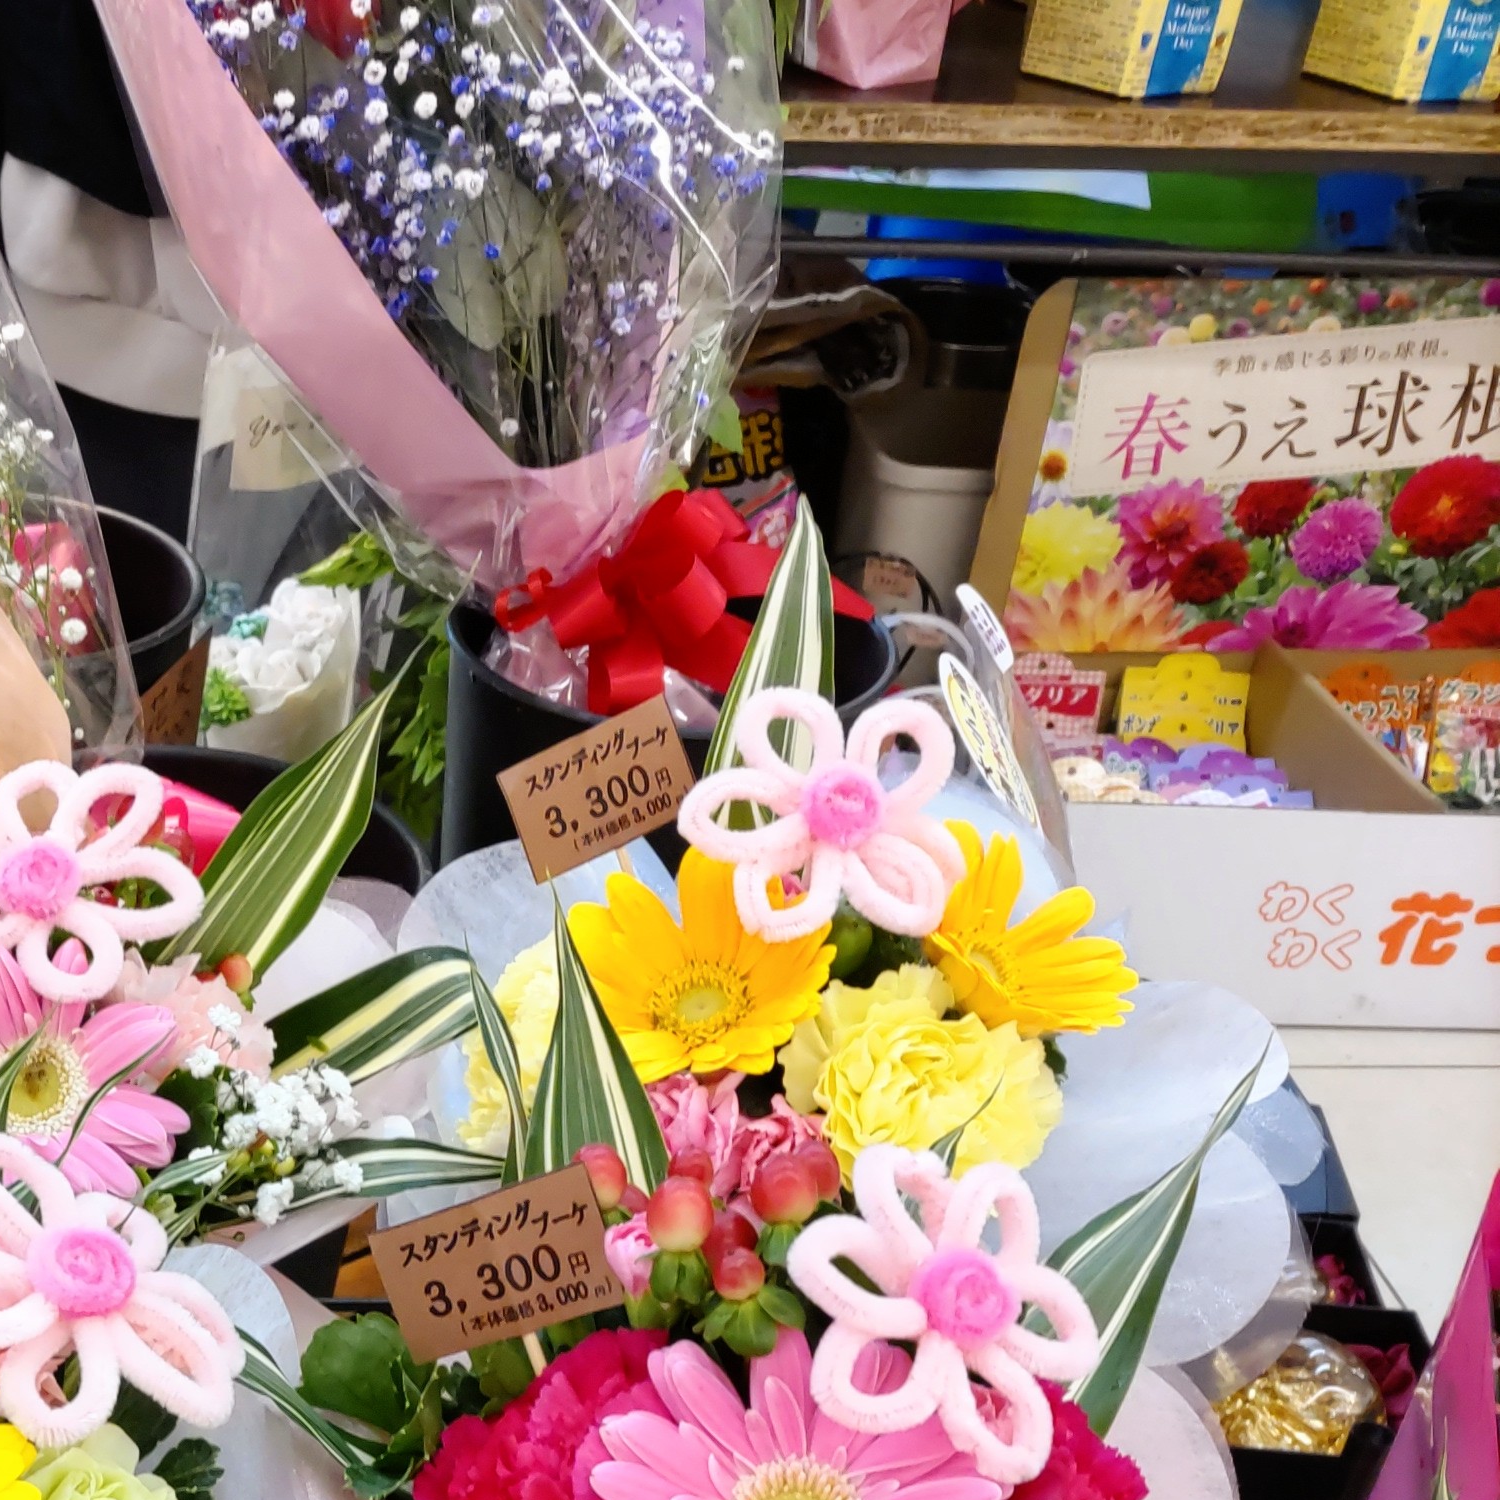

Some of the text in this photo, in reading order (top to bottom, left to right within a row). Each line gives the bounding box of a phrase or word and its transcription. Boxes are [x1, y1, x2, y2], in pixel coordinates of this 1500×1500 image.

[544, 764, 672, 839] 3,300円
[1258, 880, 1354, 926] わく
[1266, 926, 1362, 971] わく
[423, 1243, 590, 1318] 3,300円
